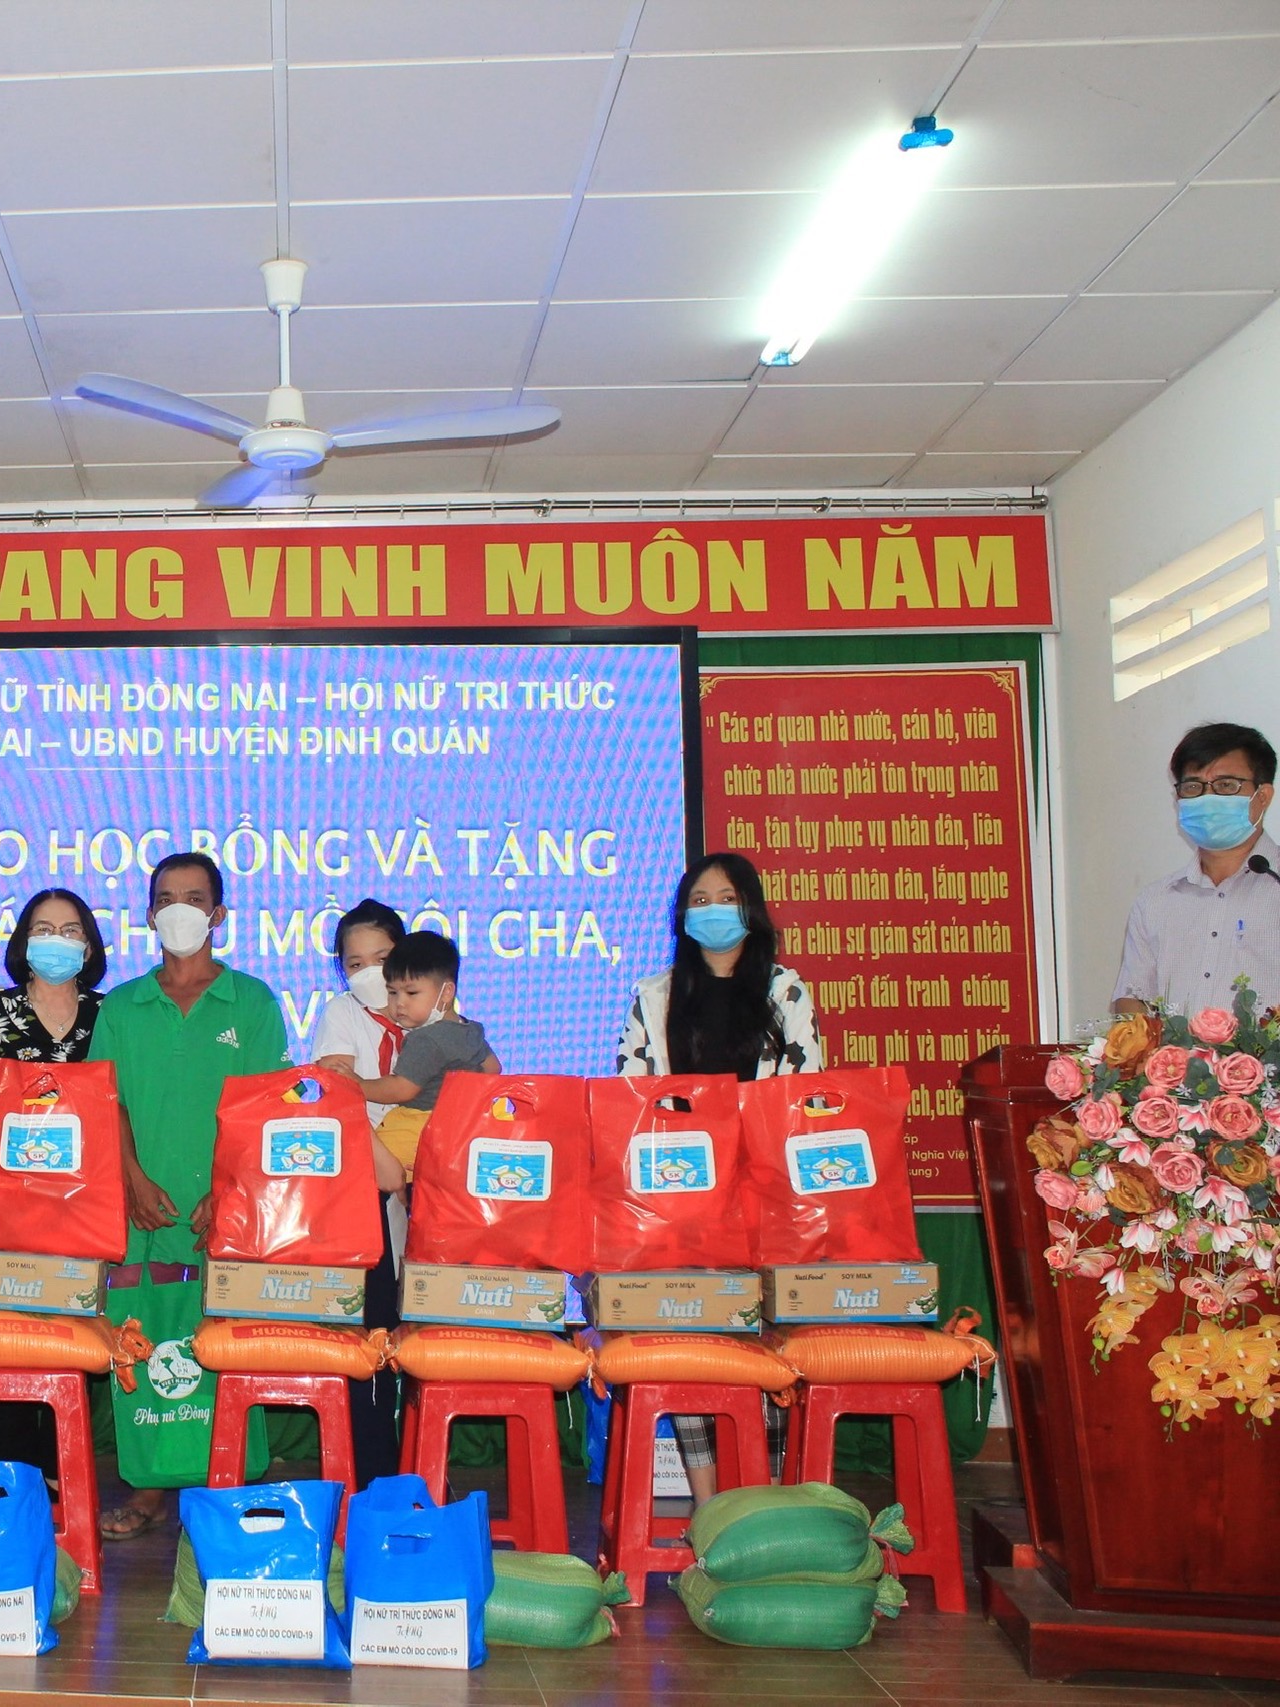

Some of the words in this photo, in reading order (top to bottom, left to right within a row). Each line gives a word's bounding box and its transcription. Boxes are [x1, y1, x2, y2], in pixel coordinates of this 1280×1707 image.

[218, 544, 446, 618] VINH
[485, 528, 767, 615] MUÔN
[804, 524, 1017, 610] NĂM
[37, 676, 111, 712] TỈNH
[121, 675, 219, 711] ĐỒNG
[231, 682, 287, 711] NAI
[325, 677, 382, 718] HỘI
[394, 675, 445, 711] NỮ
[455, 681, 508, 711] TRI
[519, 675, 614, 711] THỨC
[70, 728, 164, 757] UBND
[175, 722, 288, 762] HUYỆN
[299, 726, 380, 762] ĐỊNH
[391, 720, 489, 757] QUÁN
[754, 713, 773, 742] cơ
[777, 714, 815, 747] quan
[820, 710, 849, 742] nhà
[853, 708, 897, 745] nước,
[901, 708, 930, 741] cán
[935, 708, 959, 746] bộ,
[964, 707, 998, 740] viên
[723, 764, 762, 796] chức
[766, 763, 795, 795] nhà
[800, 762, 839, 794] nước
[843, 758, 876, 799] phải
[881, 761, 906, 793] tôn
[911, 761, 955, 799] trọng
[960, 760, 999, 792] nhân
[49, 828, 171, 889] HỌC
[366, 815, 443, 876] VÀ
[457, 821, 616, 890] TẶNG
[726, 816, 761, 853] dân,
[765, 815, 790, 855] tận
[795, 815, 819, 854] tụy
[825, 814, 863, 854] phục
[868, 820, 886, 853] vụ
[892, 813, 930, 846] nhân
[934, 813, 969, 850] dân,
[973, 812, 1003, 845] liên
[758, 867, 788, 908] hặt
[791, 867, 819, 901] chẽ
[824, 867, 847, 901] với
[851, 867, 889, 900] nhân
[894, 866, 929, 904] dân,
[932, 863, 967, 905] lắng
[970, 866, 1009, 905] nghe
[488, 908, 621, 966] CHA,
[783, 921, 802, 955] và
[807, 921, 841, 961] chịu
[846, 923, 866, 961] sự
[870, 920, 908, 960] giám
[912, 919, 937, 954] sát
[940, 916, 968, 953] của
[973, 919, 1012, 953] nhân
[819, 973, 866, 1014] quyết
[870, 974, 899, 1008] đấu
[906, 974, 950, 1007] tranh
[962, 972, 1010, 1013] chống
[843, 1030, 877, 1068] lãng
[885, 1029, 909, 1066] phí
[917, 1030, 935, 1062] và
[941, 1029, 969, 1068] mọi
[912, 1149, 945, 1161] Nghĩa
[259, 1277, 312, 1301] Nuti
[459, 1282, 514, 1307] Nuti
[656, 1298, 703, 1318] Nuti
[833, 1288, 880, 1308] Nuti
[217, 1586, 229, 1600] HỘI
[231, 1585, 241, 1598] NỮ
[256, 1586, 276, 1600] THỨC
[277, 1586, 297, 1600] ĐỒNG
[299, 1589, 311, 1600] NAI
[215, 1625, 229, 1637] CÁC
[231, 1627, 241, 1636] EM
[256, 1627, 268, 1638] CÔI
[269, 1629, 280, 1638] DO
[281, 1629, 313, 1640] COVID-19
